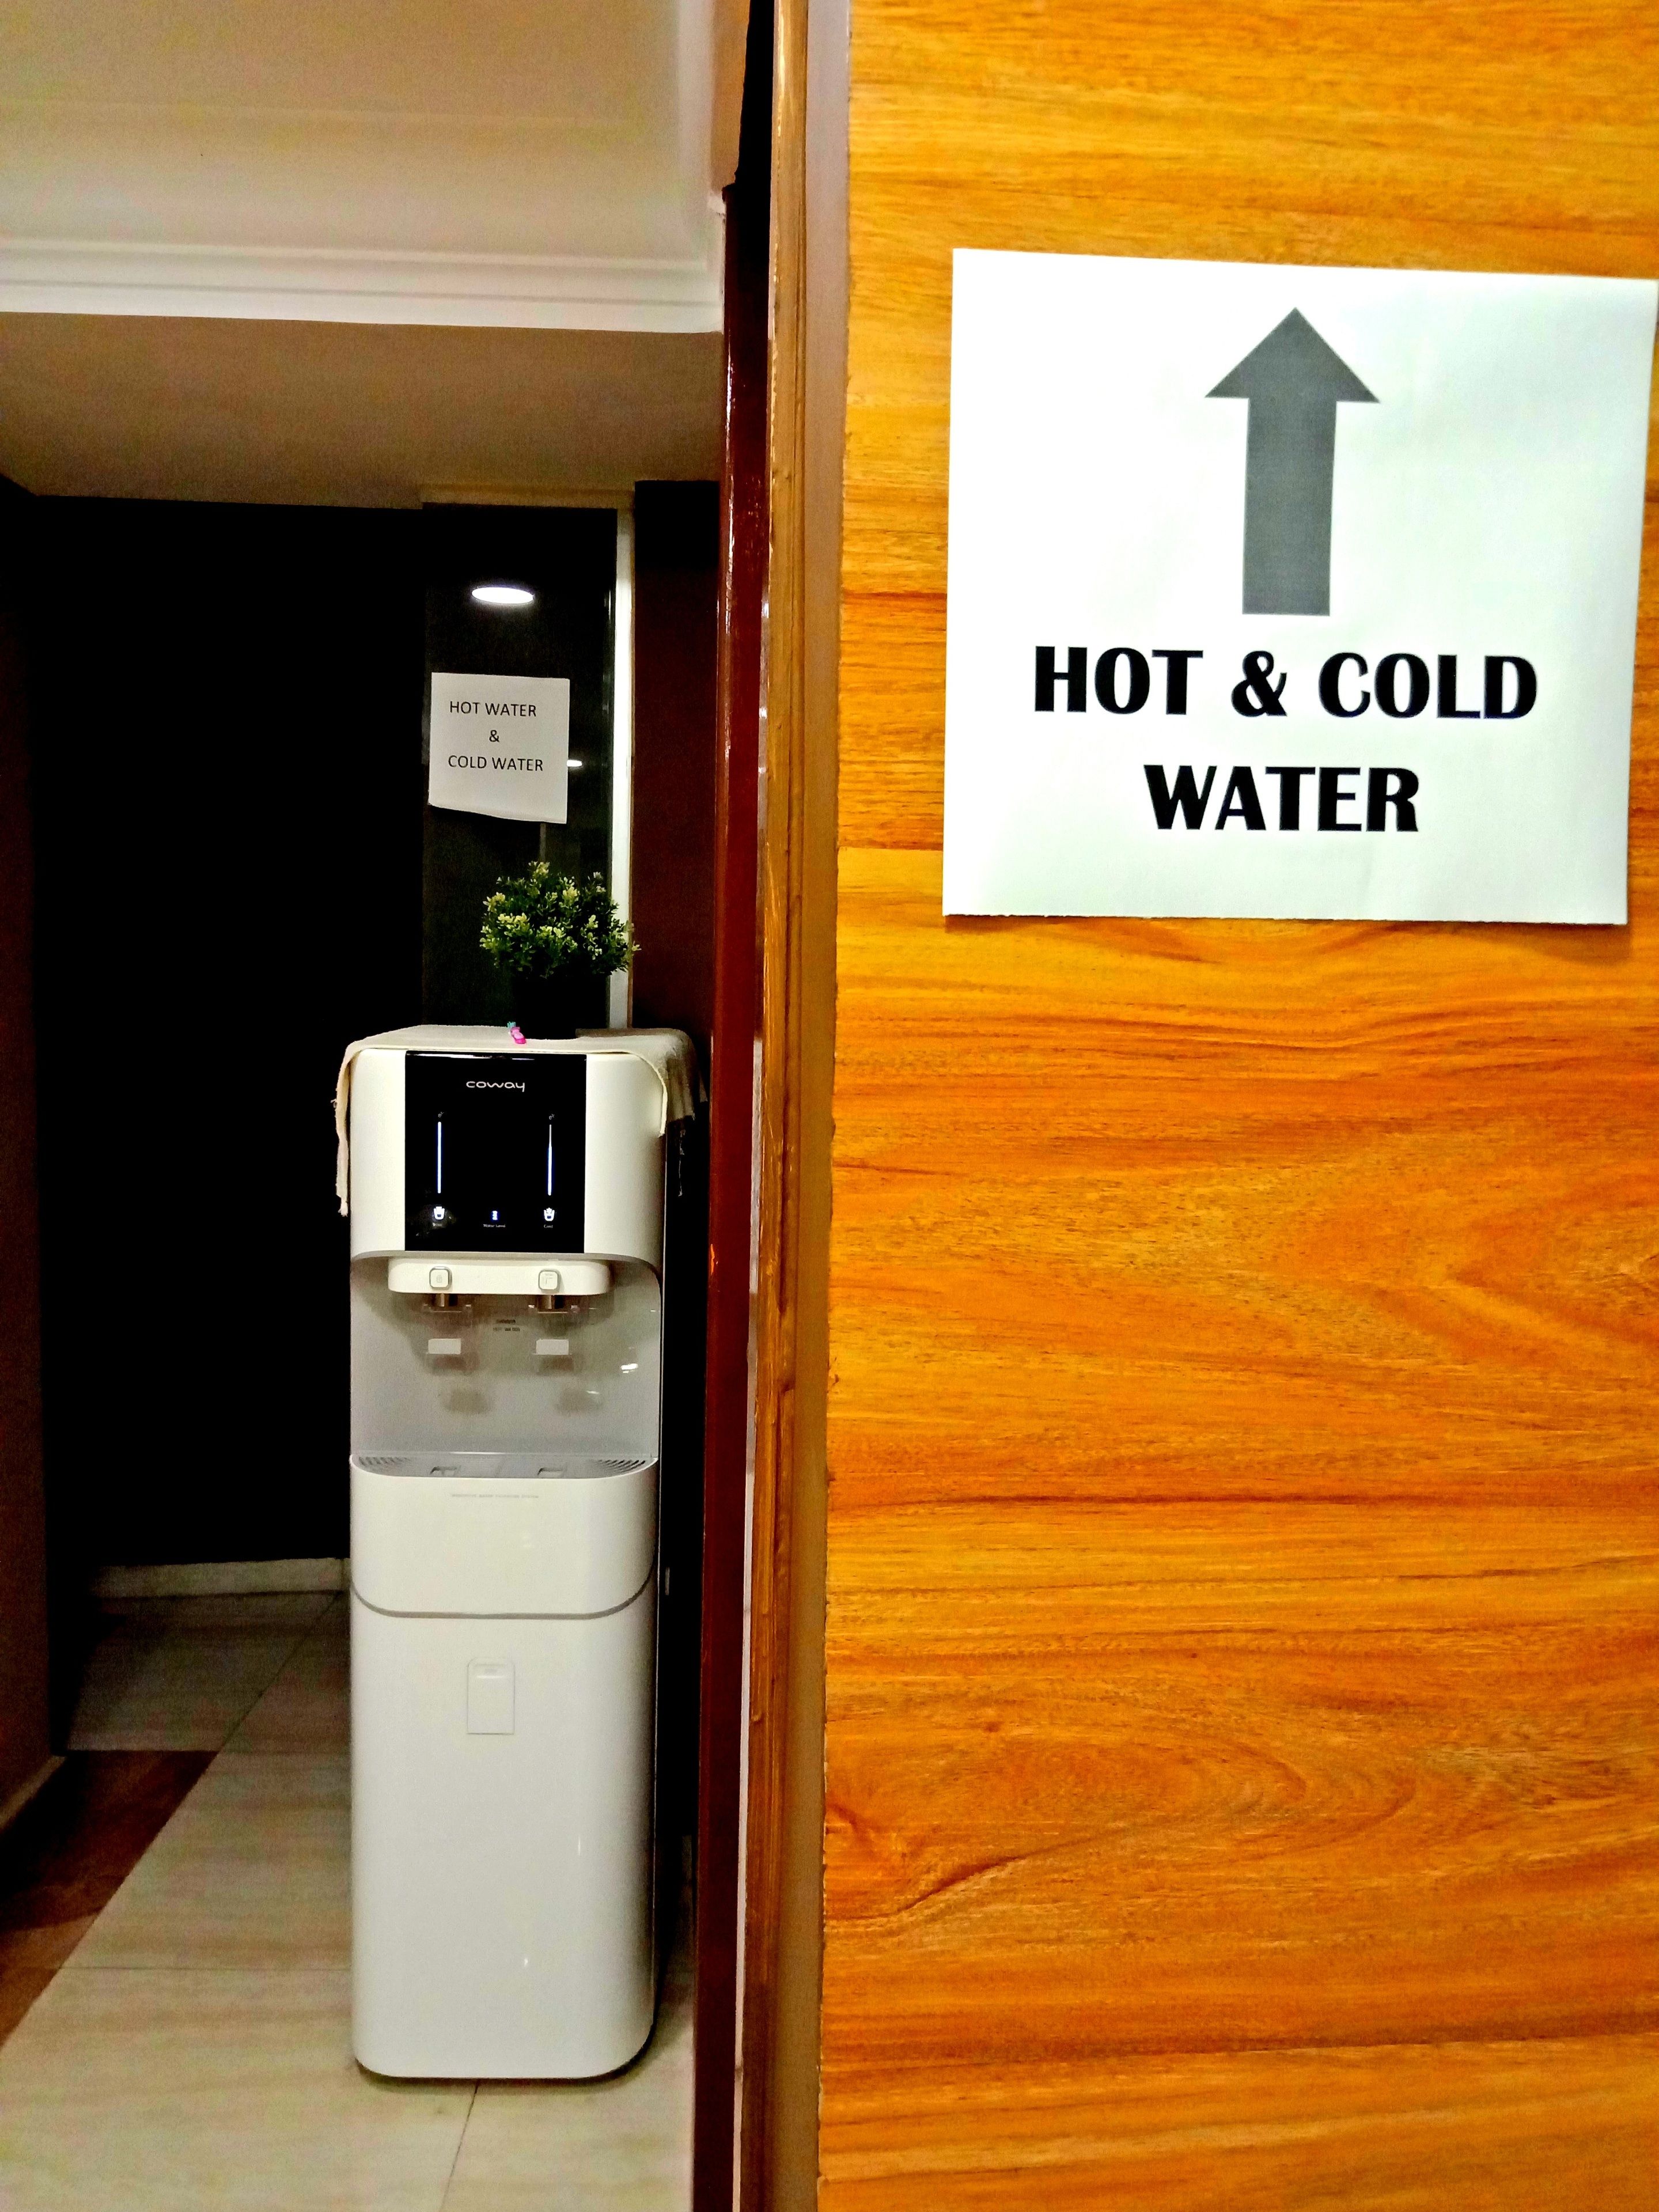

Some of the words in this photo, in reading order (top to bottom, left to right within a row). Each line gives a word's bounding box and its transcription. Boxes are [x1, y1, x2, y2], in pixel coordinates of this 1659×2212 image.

[1035, 646, 1203, 715] HOT
[1231, 650, 1287, 717] &
[1318, 652, 1537, 719] COLD
[450, 700, 480, 714] HOT
[484, 702, 536, 717] WATER
[488, 729, 500, 743] &
[448, 755, 487, 769] COLD
[491, 757, 543, 771] WATER
[1143, 764, 1419, 832] WATER
[465, 1081, 525, 1093] coway
